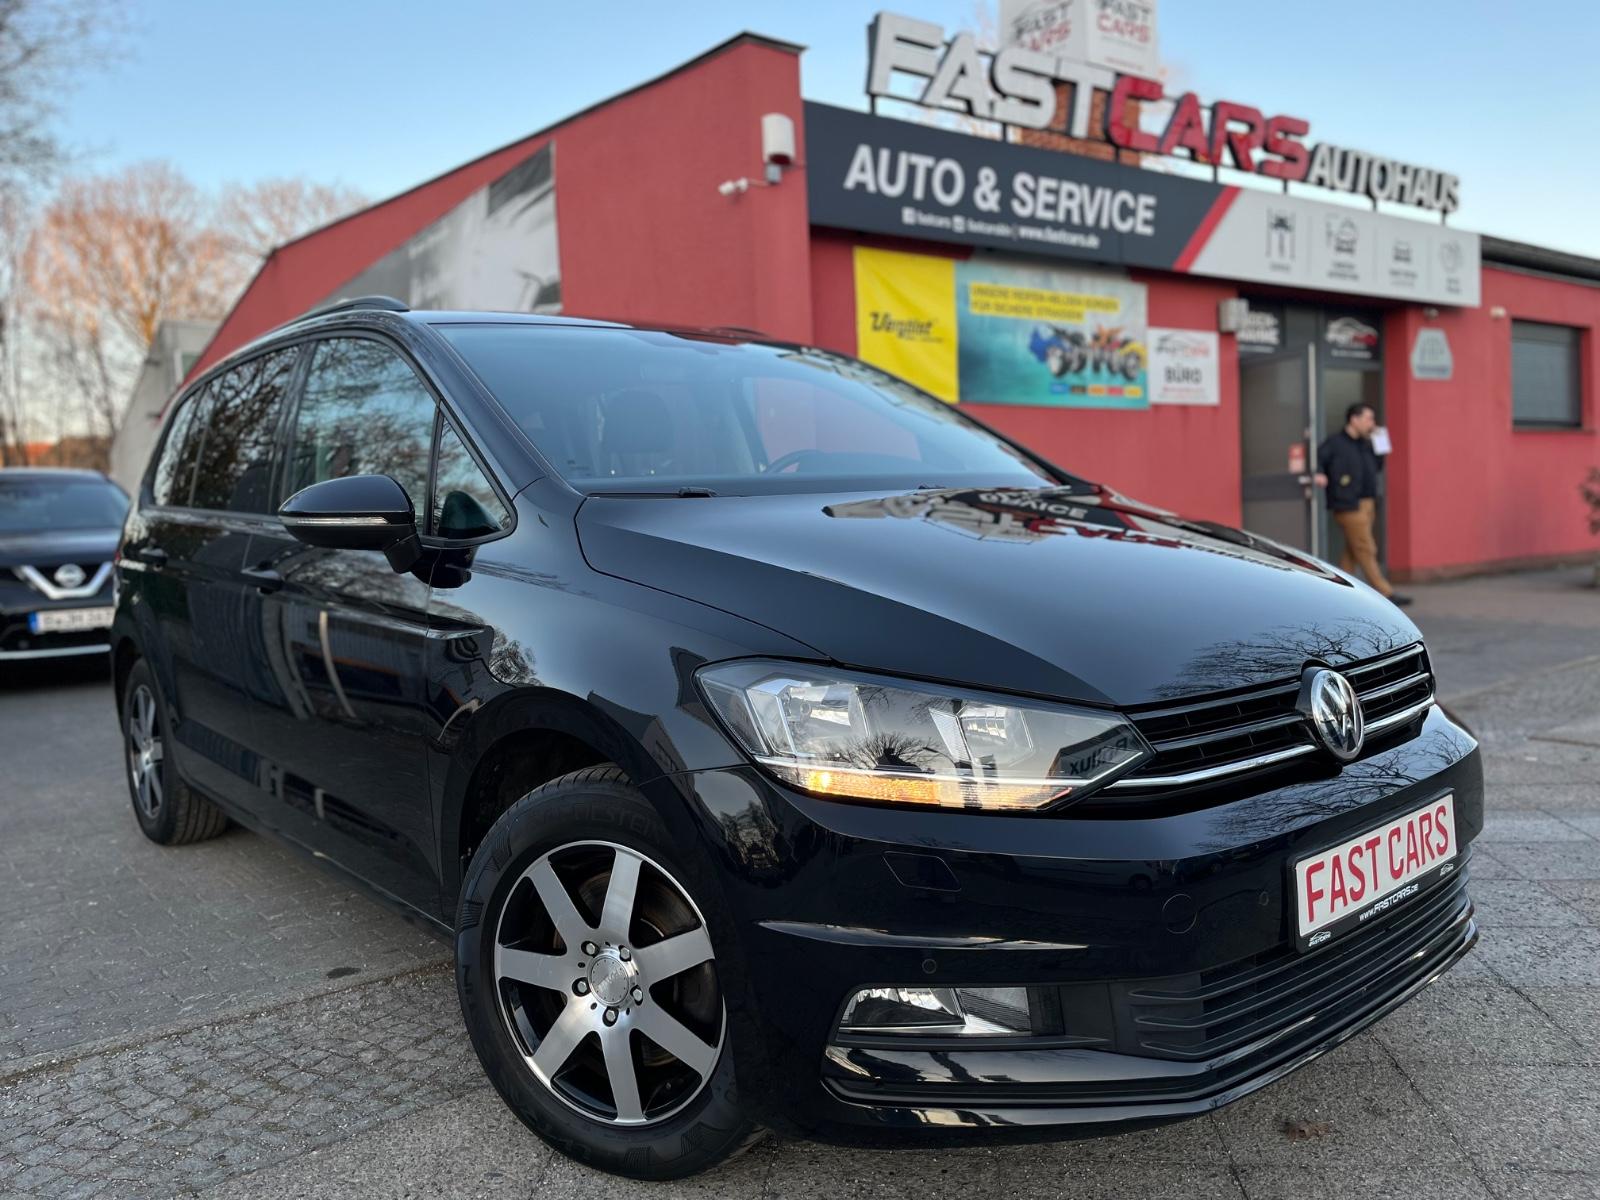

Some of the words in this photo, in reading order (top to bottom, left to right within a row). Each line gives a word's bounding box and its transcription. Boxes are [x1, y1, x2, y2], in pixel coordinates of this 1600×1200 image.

[843, 145, 965, 206] AUTO
[973, 167, 1001, 213] &
[1011, 172, 1157, 236] SERVICE
[1307, 144, 1460, 212] AUTOHAUS
[1164, 363, 1203, 384] BÜRO
[1305, 835, 1381, 923] FAST
[1387, 805, 1449, 880] CARS
